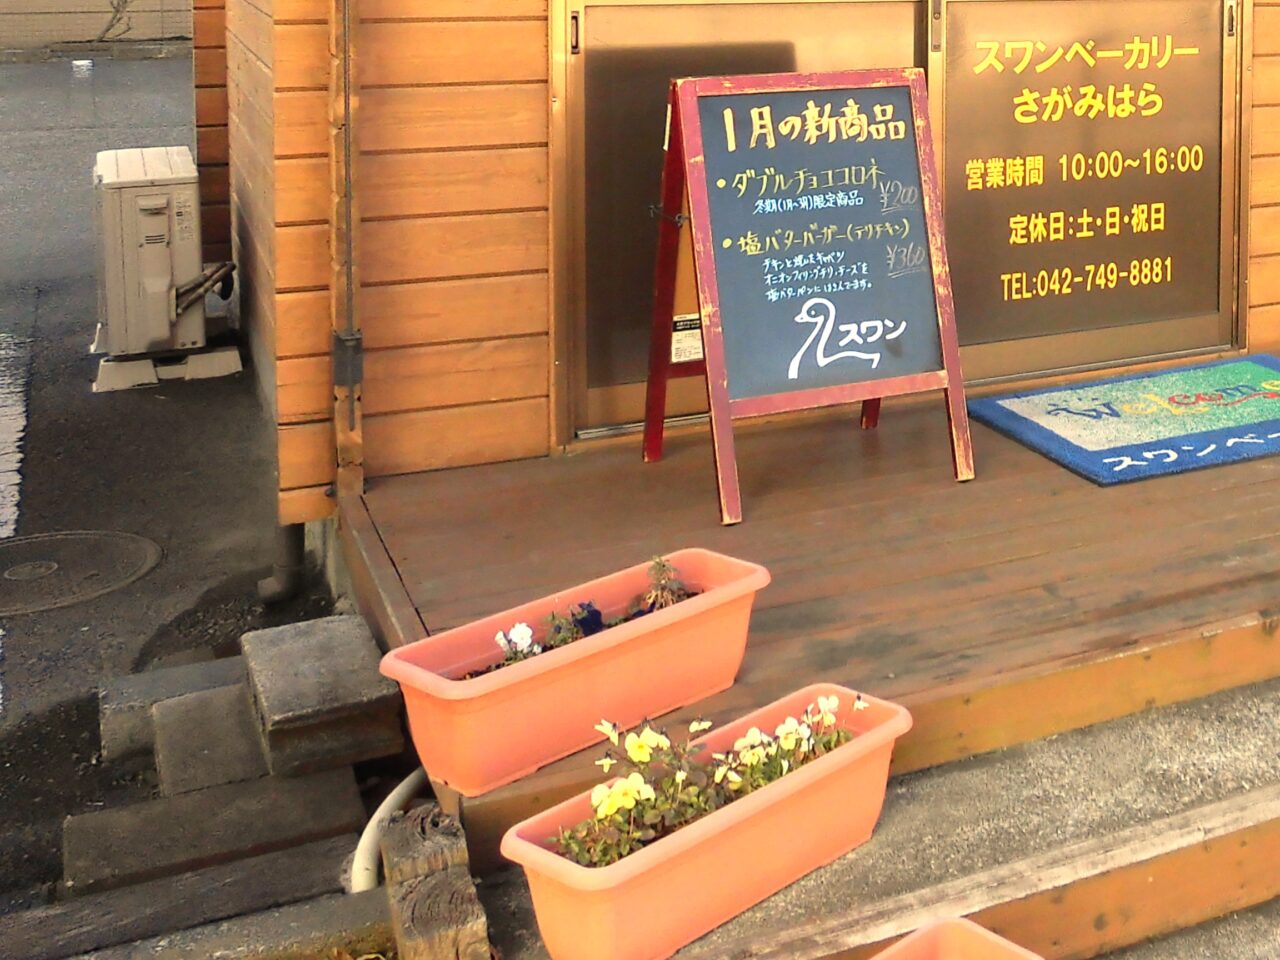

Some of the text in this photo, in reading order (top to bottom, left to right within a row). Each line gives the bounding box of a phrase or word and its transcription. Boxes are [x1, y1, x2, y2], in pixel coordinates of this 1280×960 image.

[972, 34, 1200, 75] スワンベーカリー
[1012, 82, 1163, 124] さがみはら
[723, 98, 906, 152] 1月の新商品
[965, 154, 1044, 191] 営業時間
[1000, 256, 1173, 301] TEL:042-749-8881
[838, 318, 908, 348] スワン
